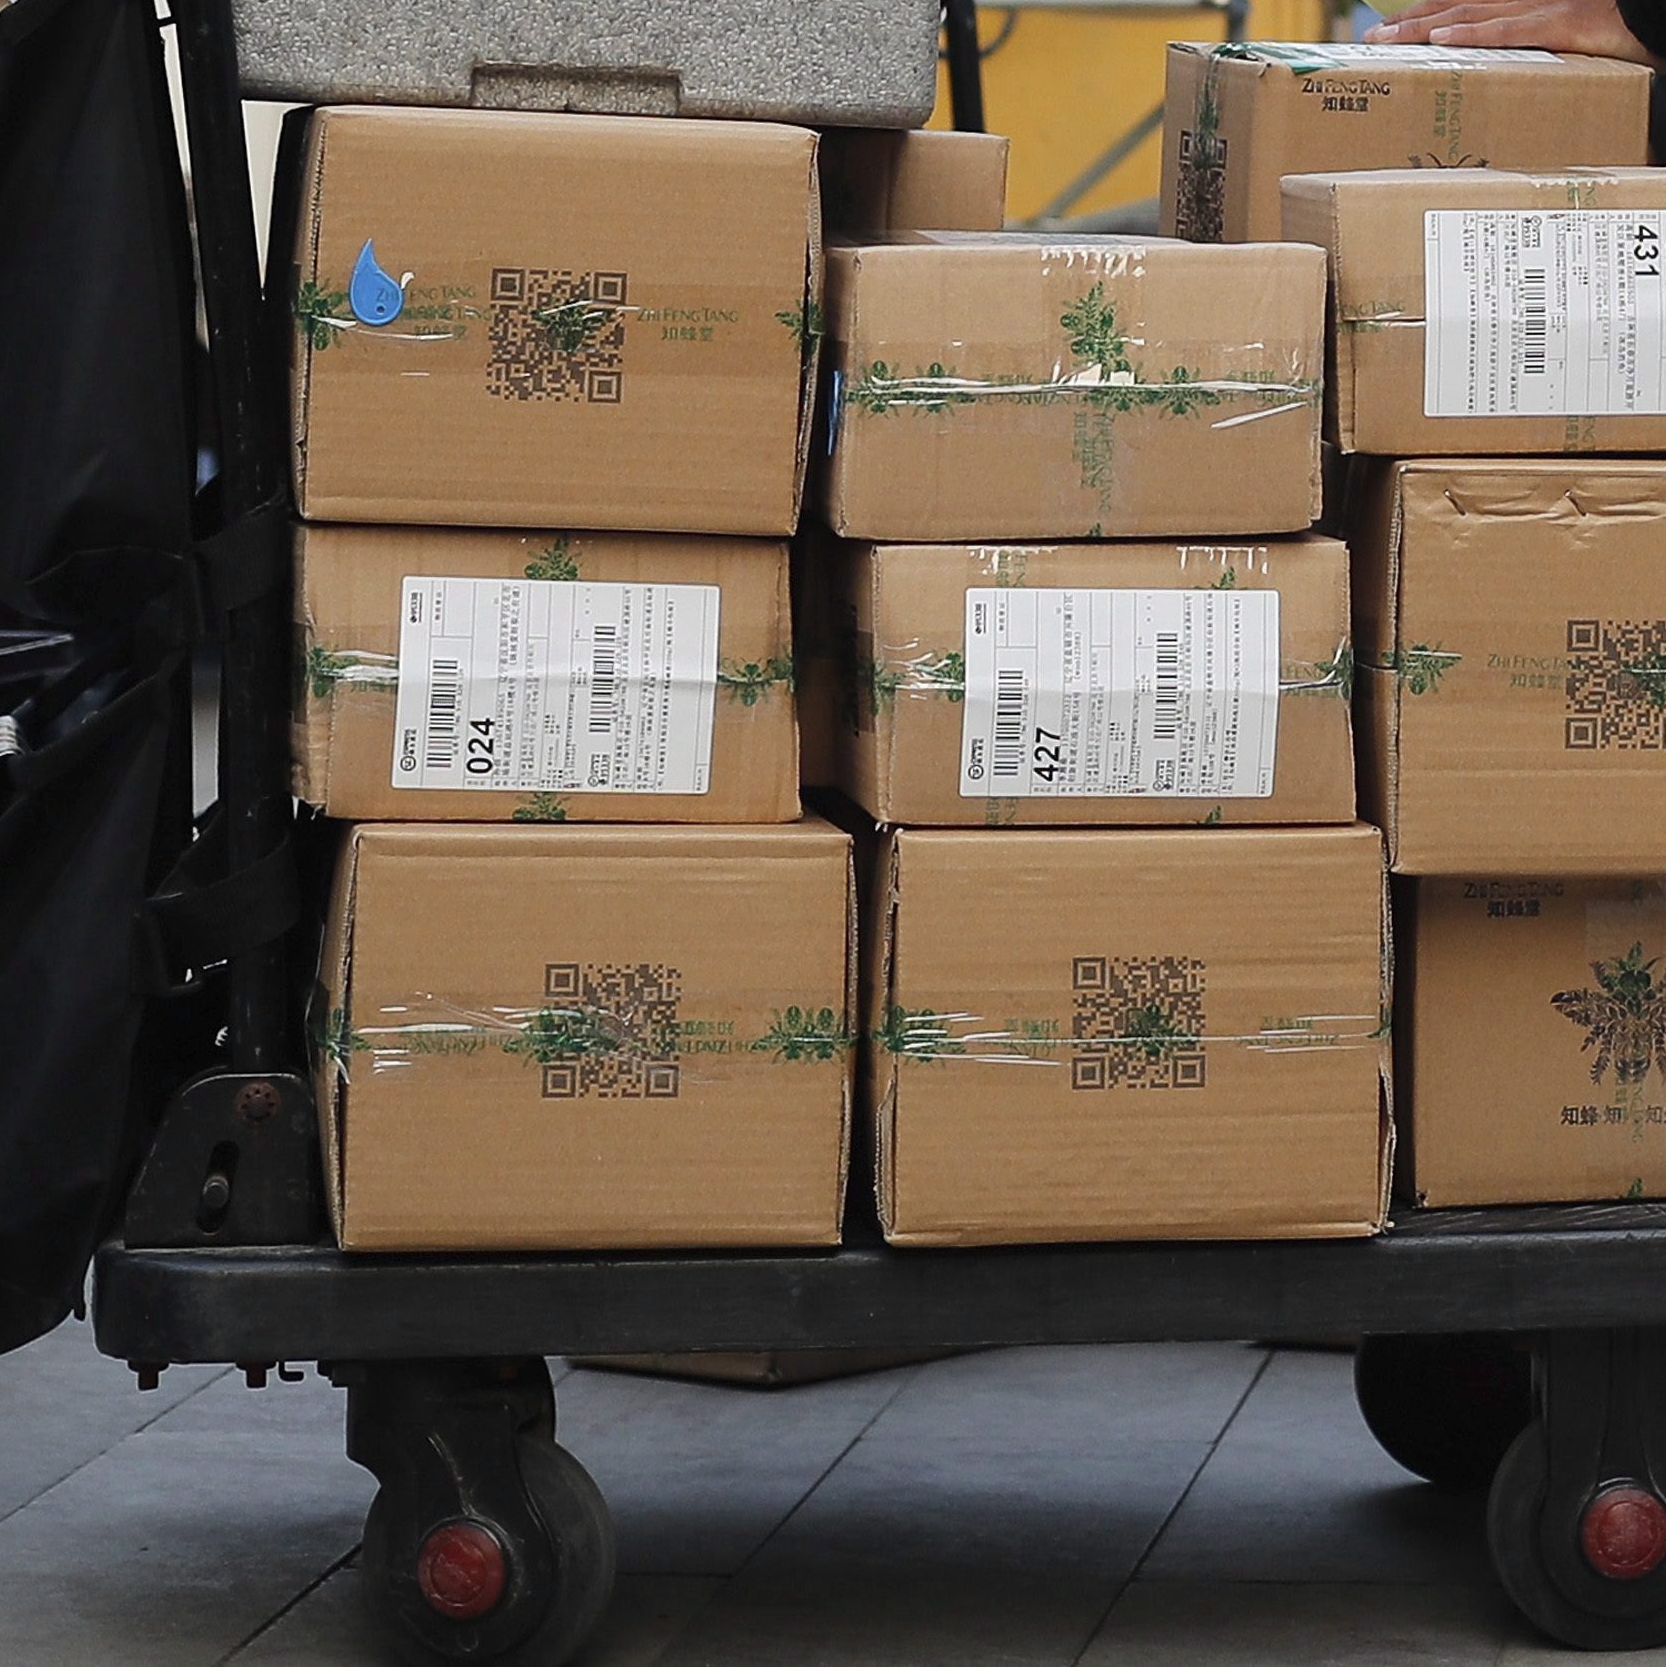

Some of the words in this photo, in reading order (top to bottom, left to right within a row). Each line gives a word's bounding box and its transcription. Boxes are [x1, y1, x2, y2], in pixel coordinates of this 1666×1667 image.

[1632, 223, 1659, 278] 431
[466, 717, 495, 775] 024
[1033, 726, 1062, 784] 427
